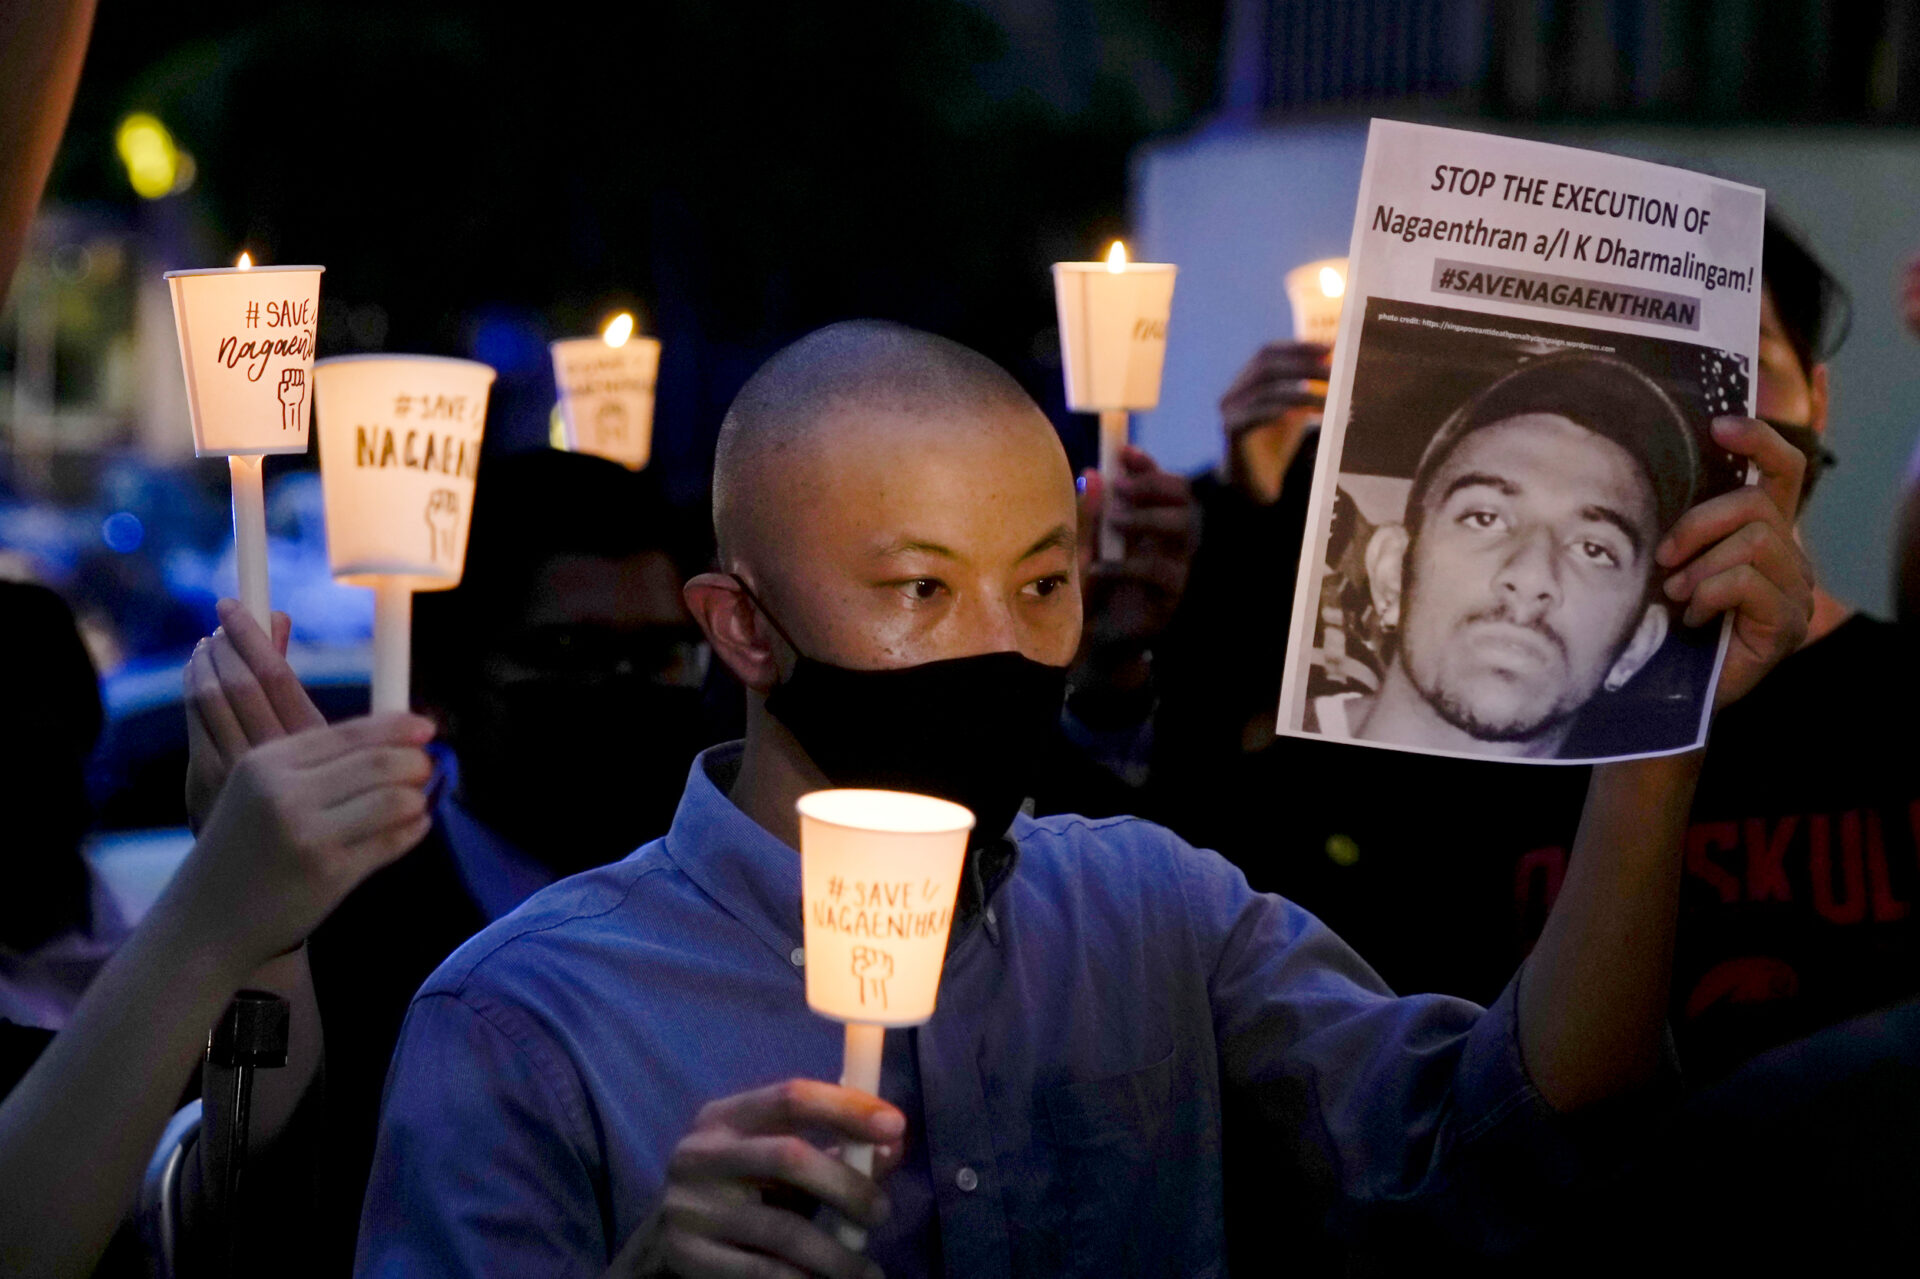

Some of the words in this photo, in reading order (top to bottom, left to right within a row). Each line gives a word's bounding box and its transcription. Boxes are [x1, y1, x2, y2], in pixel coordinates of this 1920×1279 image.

[1431, 164, 1496, 197] STOP
[1502, 174, 1548, 206] THE
[1552, 182, 1678, 229] EXECUTION
[1683, 206, 1711, 235] OF
[1372, 205, 1527, 253] Nagaenthran
[1573, 234, 1592, 261] K
[1595, 238, 1755, 293] Dharmalingam!
[1378, 312, 1399, 322] photo
[1438, 267, 1695, 325] #SAVENAGAENTHRAN
